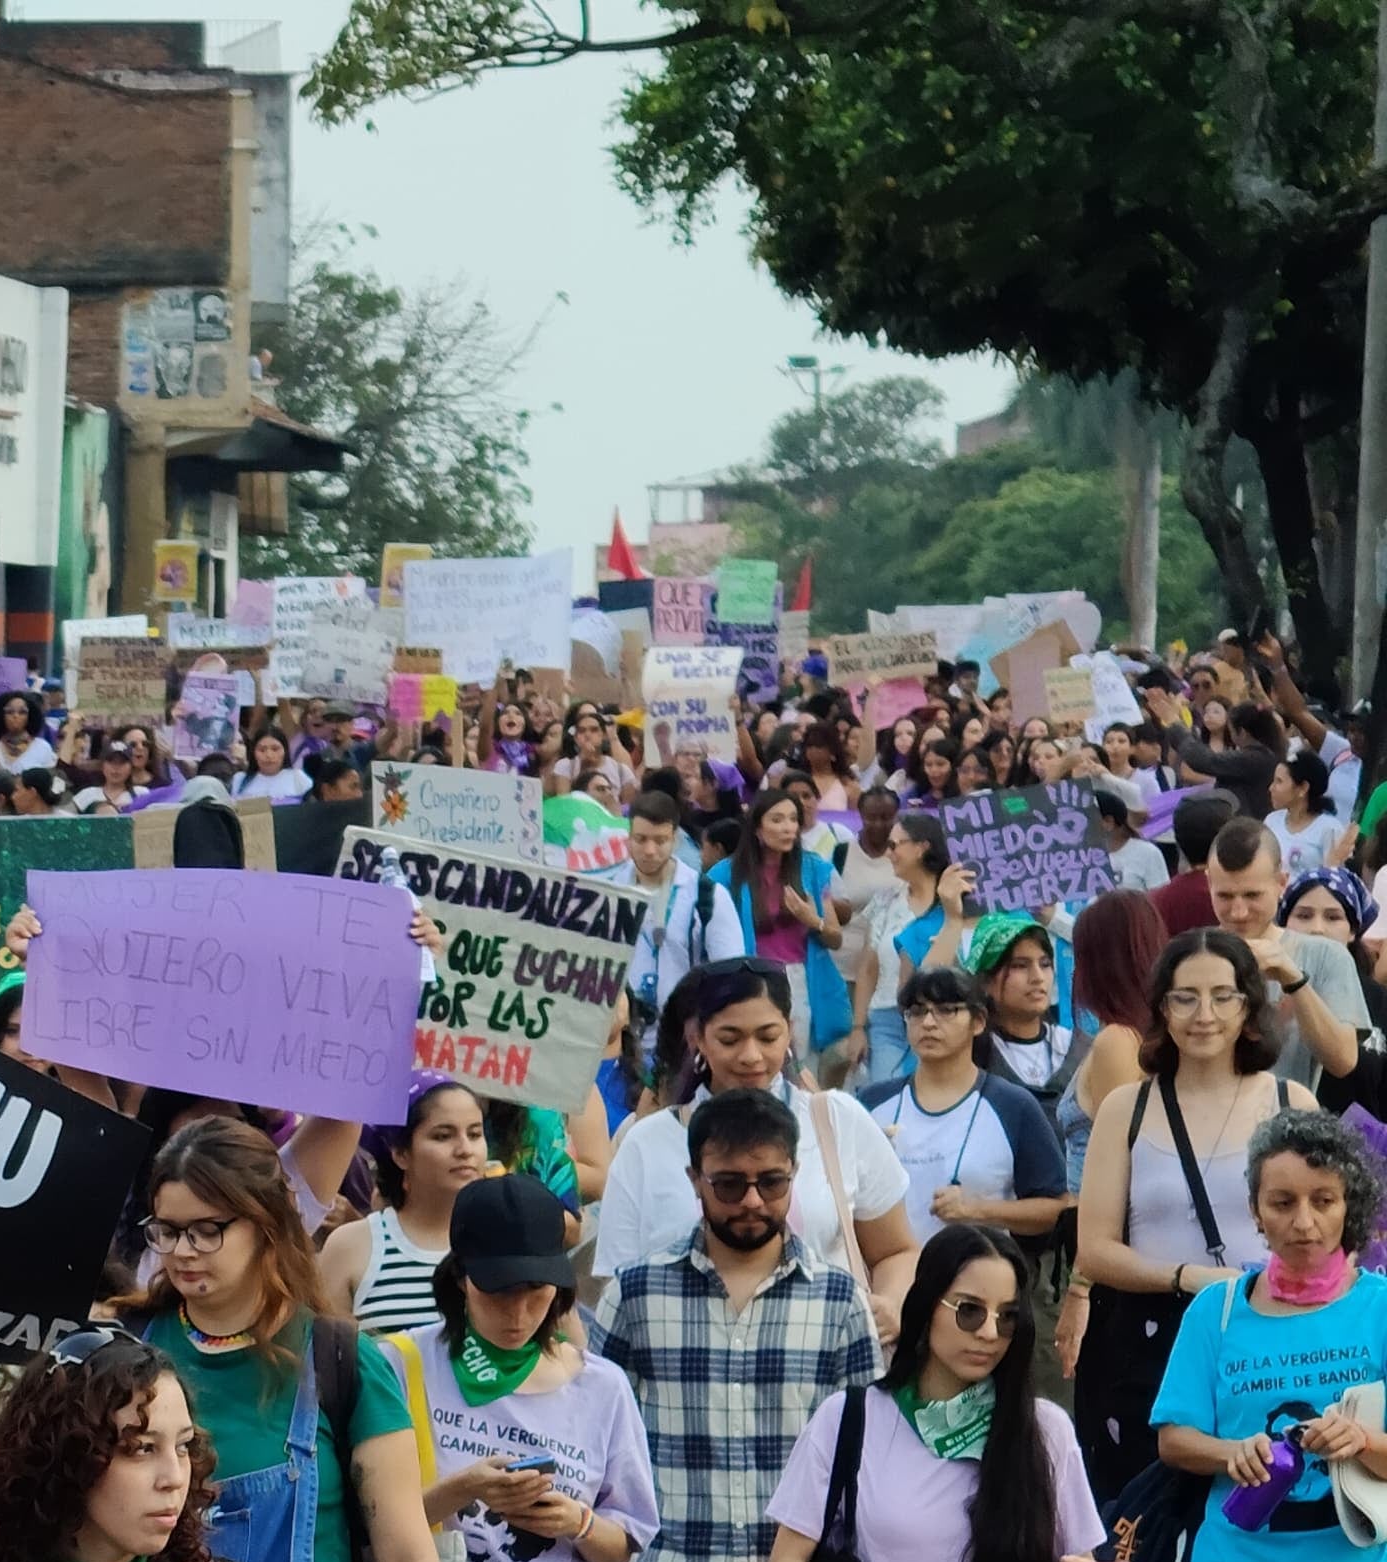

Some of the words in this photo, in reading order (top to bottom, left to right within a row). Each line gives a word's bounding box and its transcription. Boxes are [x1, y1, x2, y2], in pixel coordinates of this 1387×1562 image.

[944, 797, 994, 833] MI
[947, 823, 1054, 867] MIEDO
[293, 884, 381, 952] TE
[41, 912, 247, 997] QUIERO
[278, 955, 395, 1031] VIVA
[447, 923, 505, 977] QUE
[514, 937, 629, 1009] LUCHAN
[29, 974, 161, 1054] LIBRE
[487, 989, 555, 1040] LAS
[1225, 1359, 1248, 1377] QUE
[1253, 1356, 1273, 1370] LA
[1231, 1376, 1287, 1396] CAMBIE
[1293, 1374, 1312, 1388] DE
[1319, 1367, 1370, 1385] BANDO
[433, 1407, 465, 1428] QUE
[469, 1417, 489, 1435] LA
[439, 1434, 501, 1458] CAMBIE
